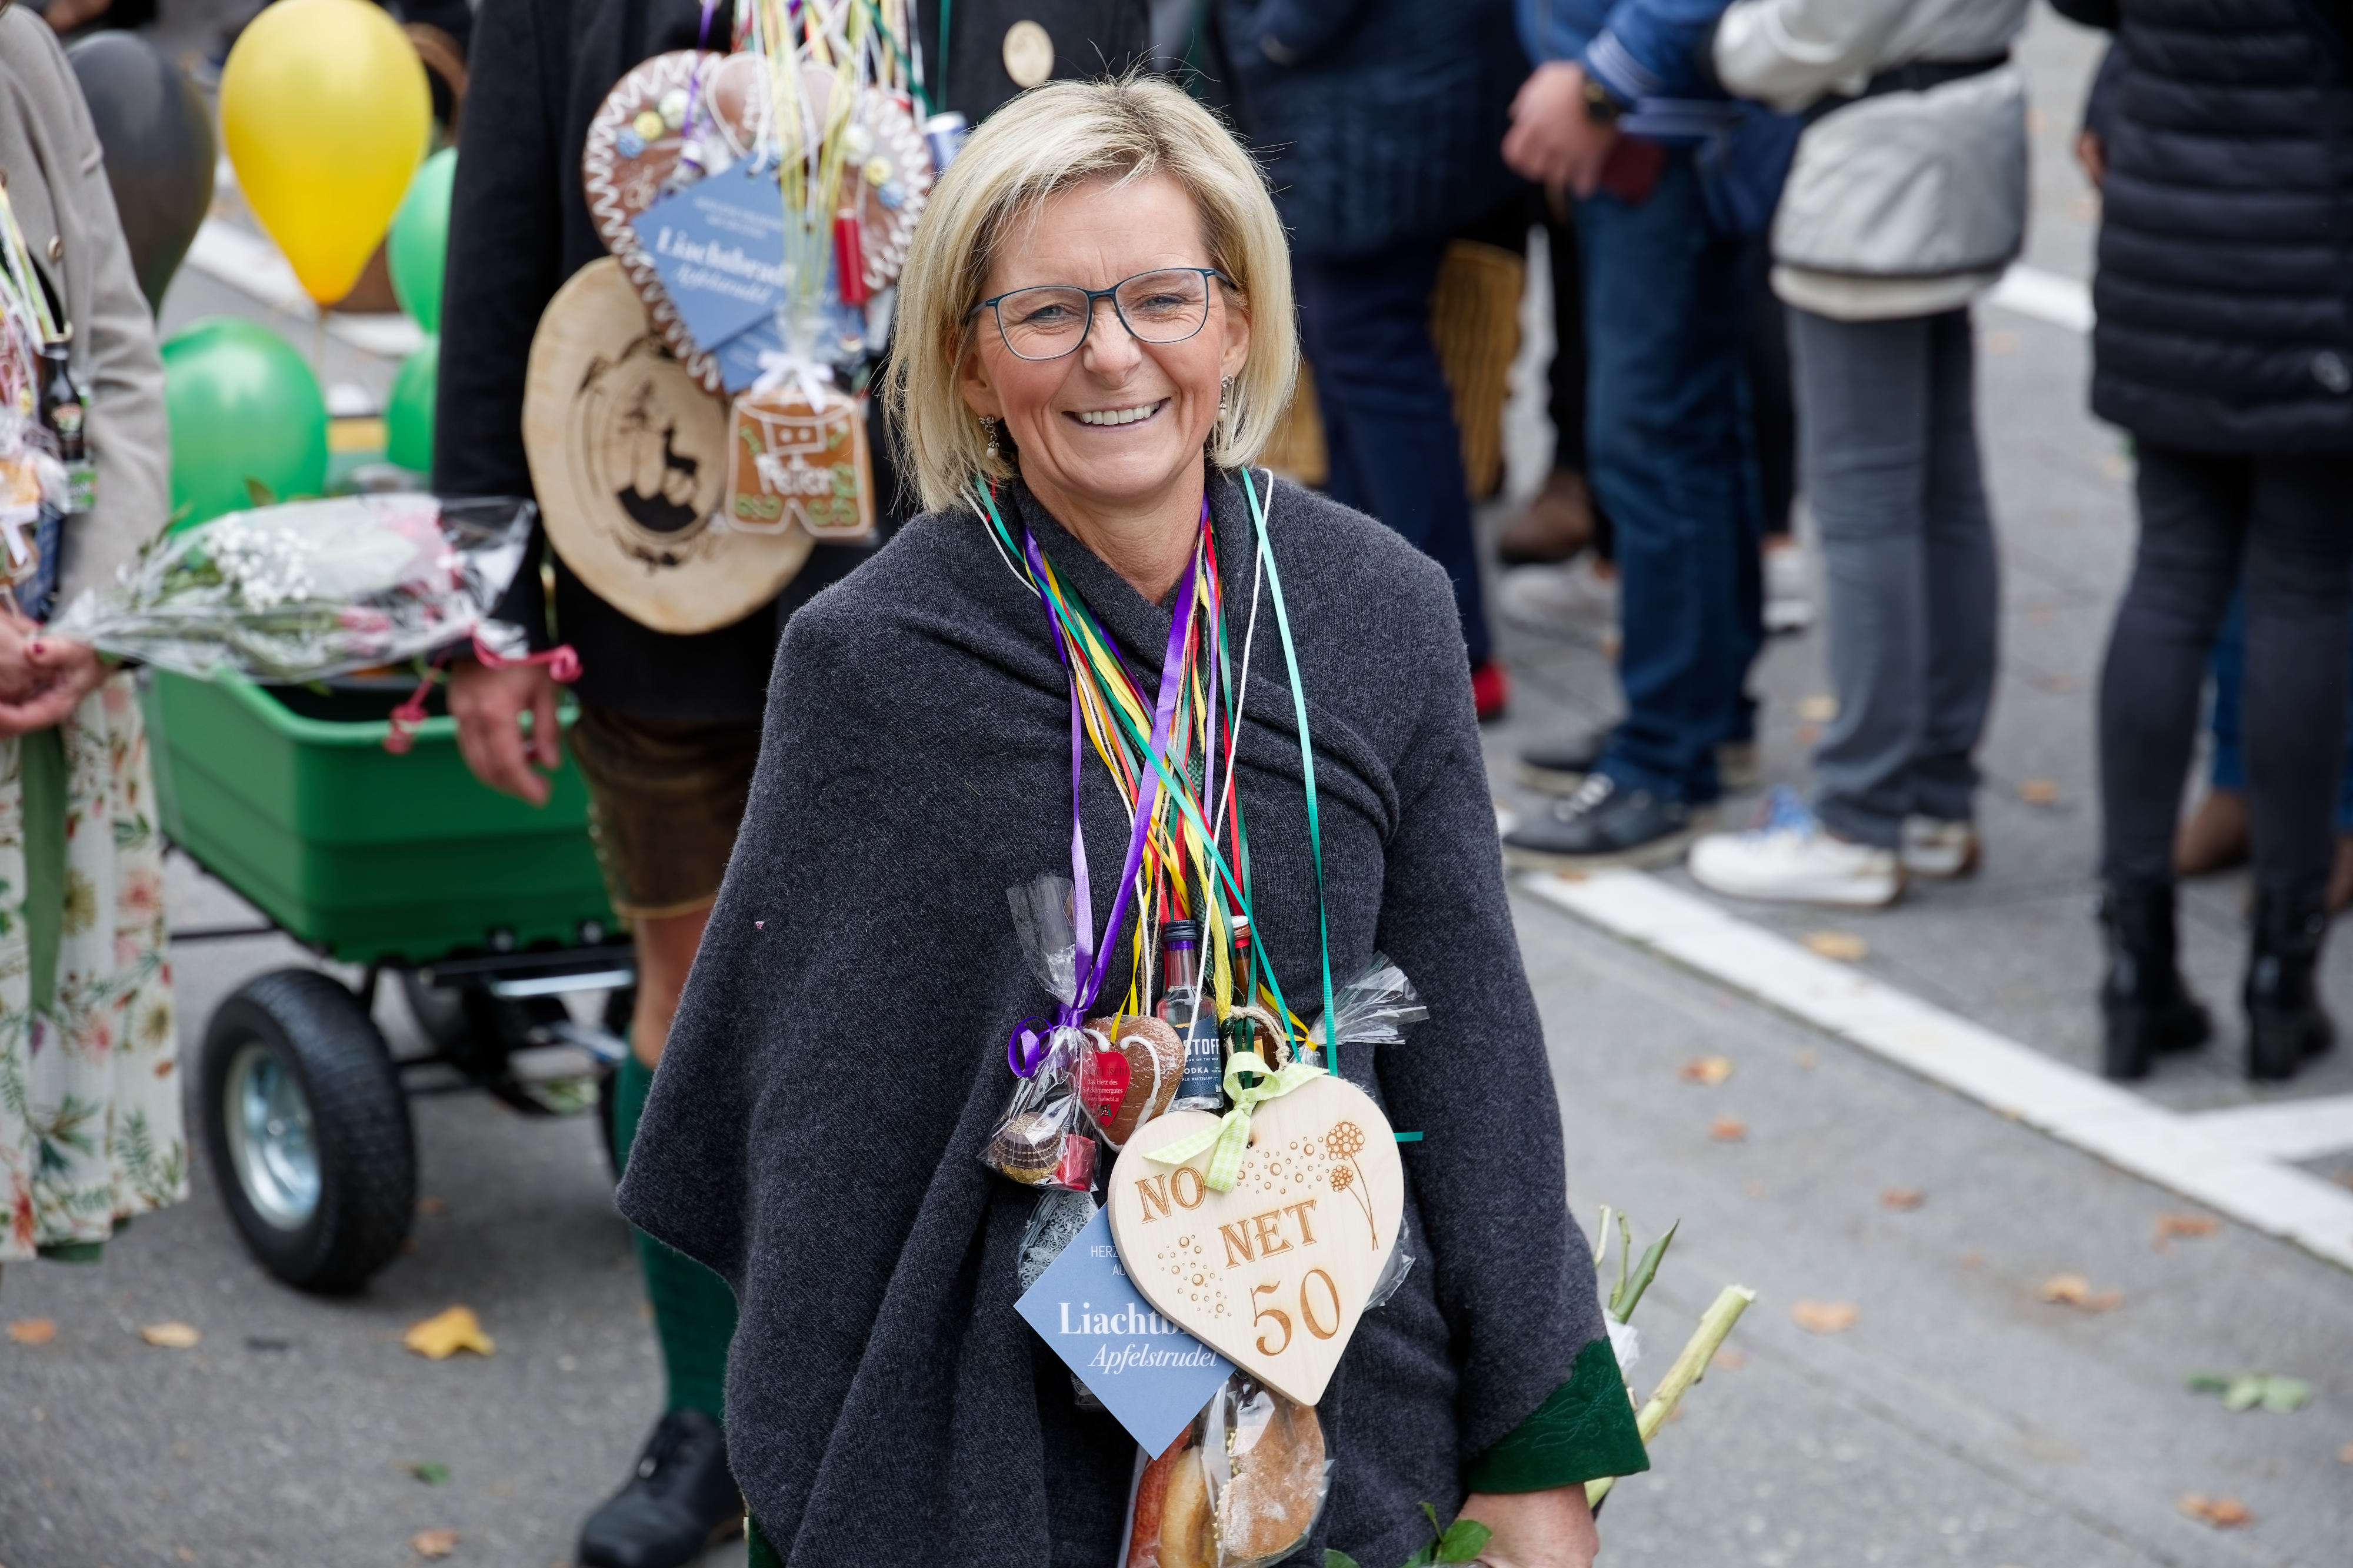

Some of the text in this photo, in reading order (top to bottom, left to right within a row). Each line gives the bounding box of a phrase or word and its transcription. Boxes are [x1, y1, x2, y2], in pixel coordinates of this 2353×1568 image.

[1107, 1065, 1127, 1076] ischl
[1082, 1086, 1123, 1095] Salzkammergutes
[1134, 1167, 1206, 1224] NO
[1218, 1199, 1317, 1270] NET
[1091, 1246, 1119, 1257] HERZ
[1112, 1265, 1126, 1276] AU
[1058, 1302, 1189, 1335] Liachtb
[1250, 1269, 1339, 1356] 50
[1087, 1343, 1217, 1374] Apfelstrudel
